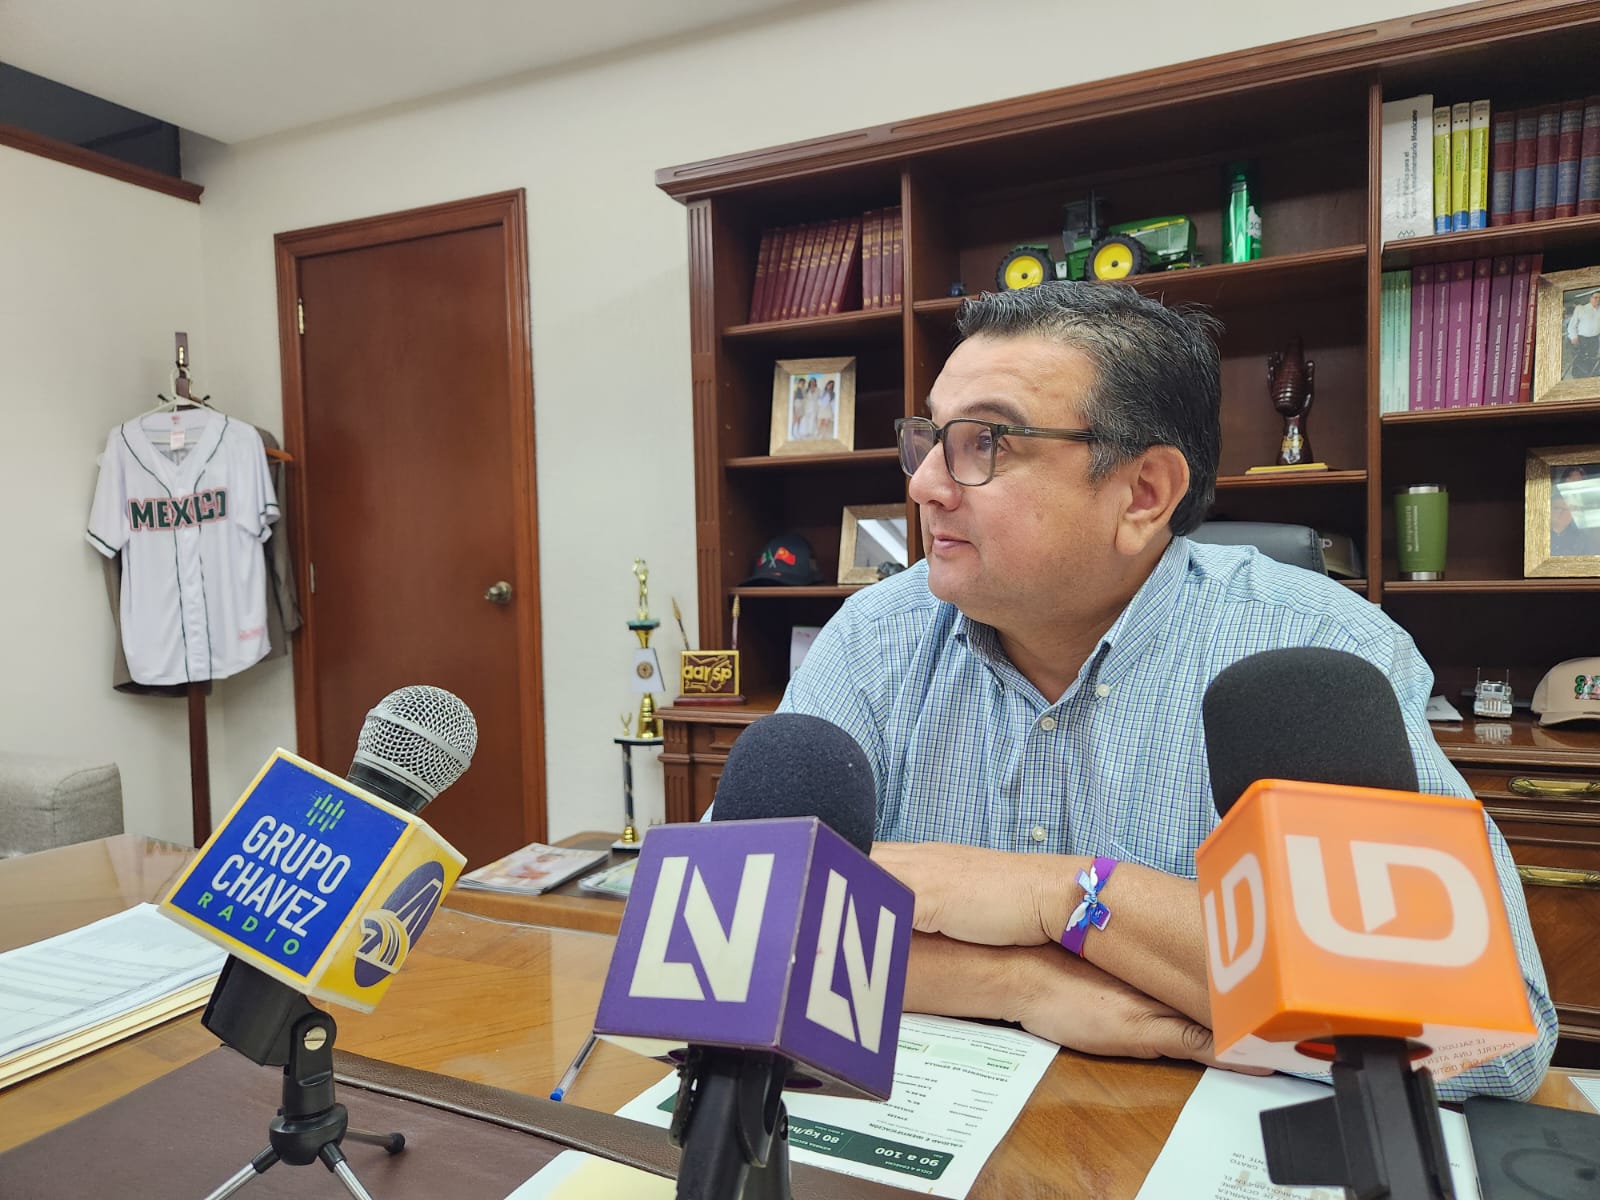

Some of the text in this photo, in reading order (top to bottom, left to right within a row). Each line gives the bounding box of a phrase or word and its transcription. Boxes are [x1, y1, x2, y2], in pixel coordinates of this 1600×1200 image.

[128, 488, 229, 532] MEXICO
[241, 815, 351, 894] GRUPO
[211, 854, 327, 937] CHAVEZ
[197, 891, 301, 955] RADIO
[822, 1134, 840, 1144] 80
[874, 1147, 904, 1159] 100
[919, 1158, 940, 1167] 90
